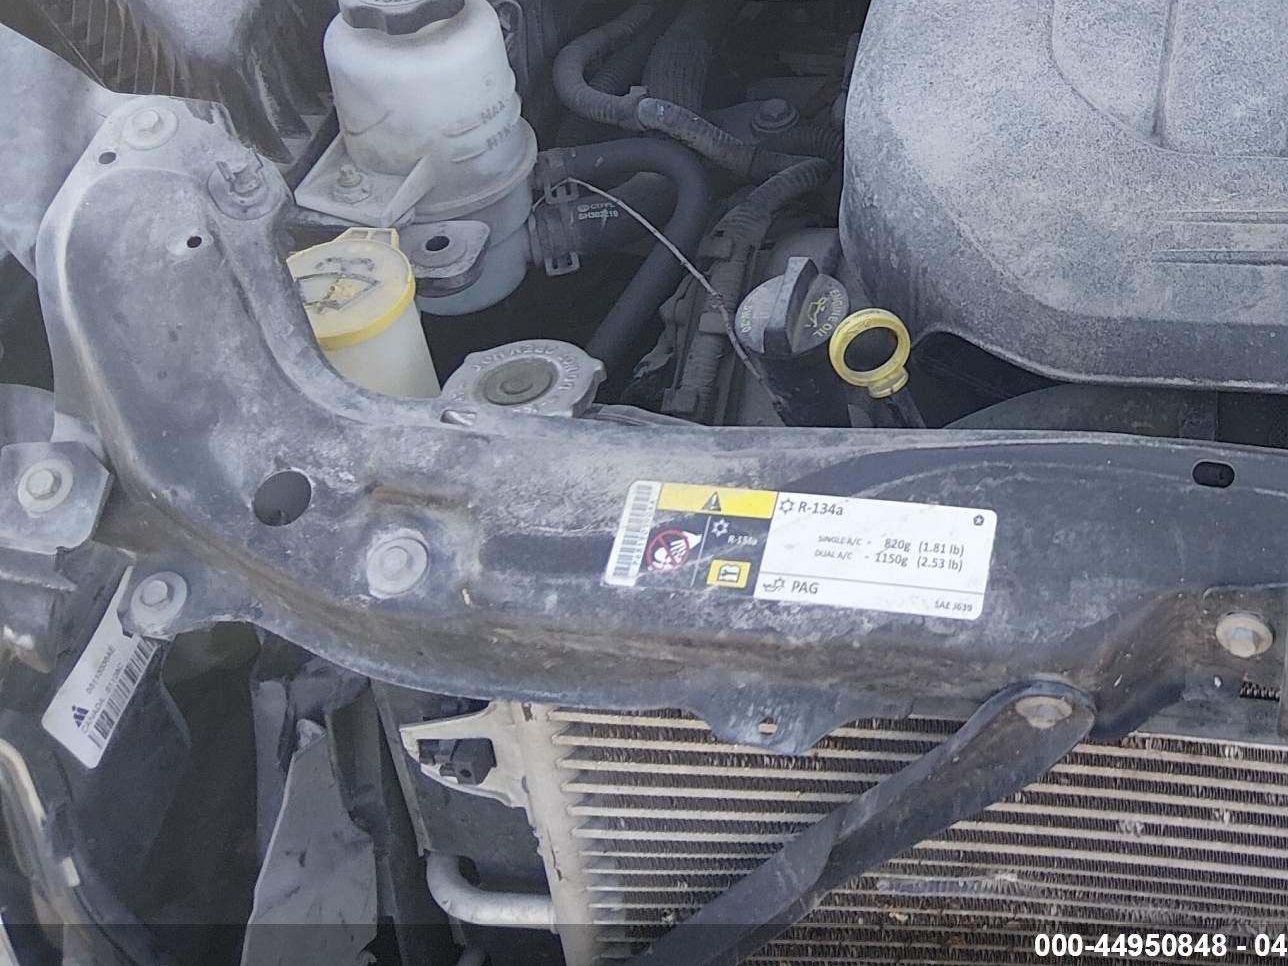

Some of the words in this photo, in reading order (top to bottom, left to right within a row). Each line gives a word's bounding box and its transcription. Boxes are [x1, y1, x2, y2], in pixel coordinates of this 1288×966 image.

[812, 323, 833, 338] OIL
[798, 501, 844, 516] R-134a
[884, 537, 911, 553] 820g
[918, 542, 946, 555] (1.81
[949, 543, 965, 557] lb)
[875, 553, 909, 568] 1150g
[917, 556, 945, 570] (2.53
[948, 558, 964, 572] lb)
[791, 580, 820, 595] PAG
